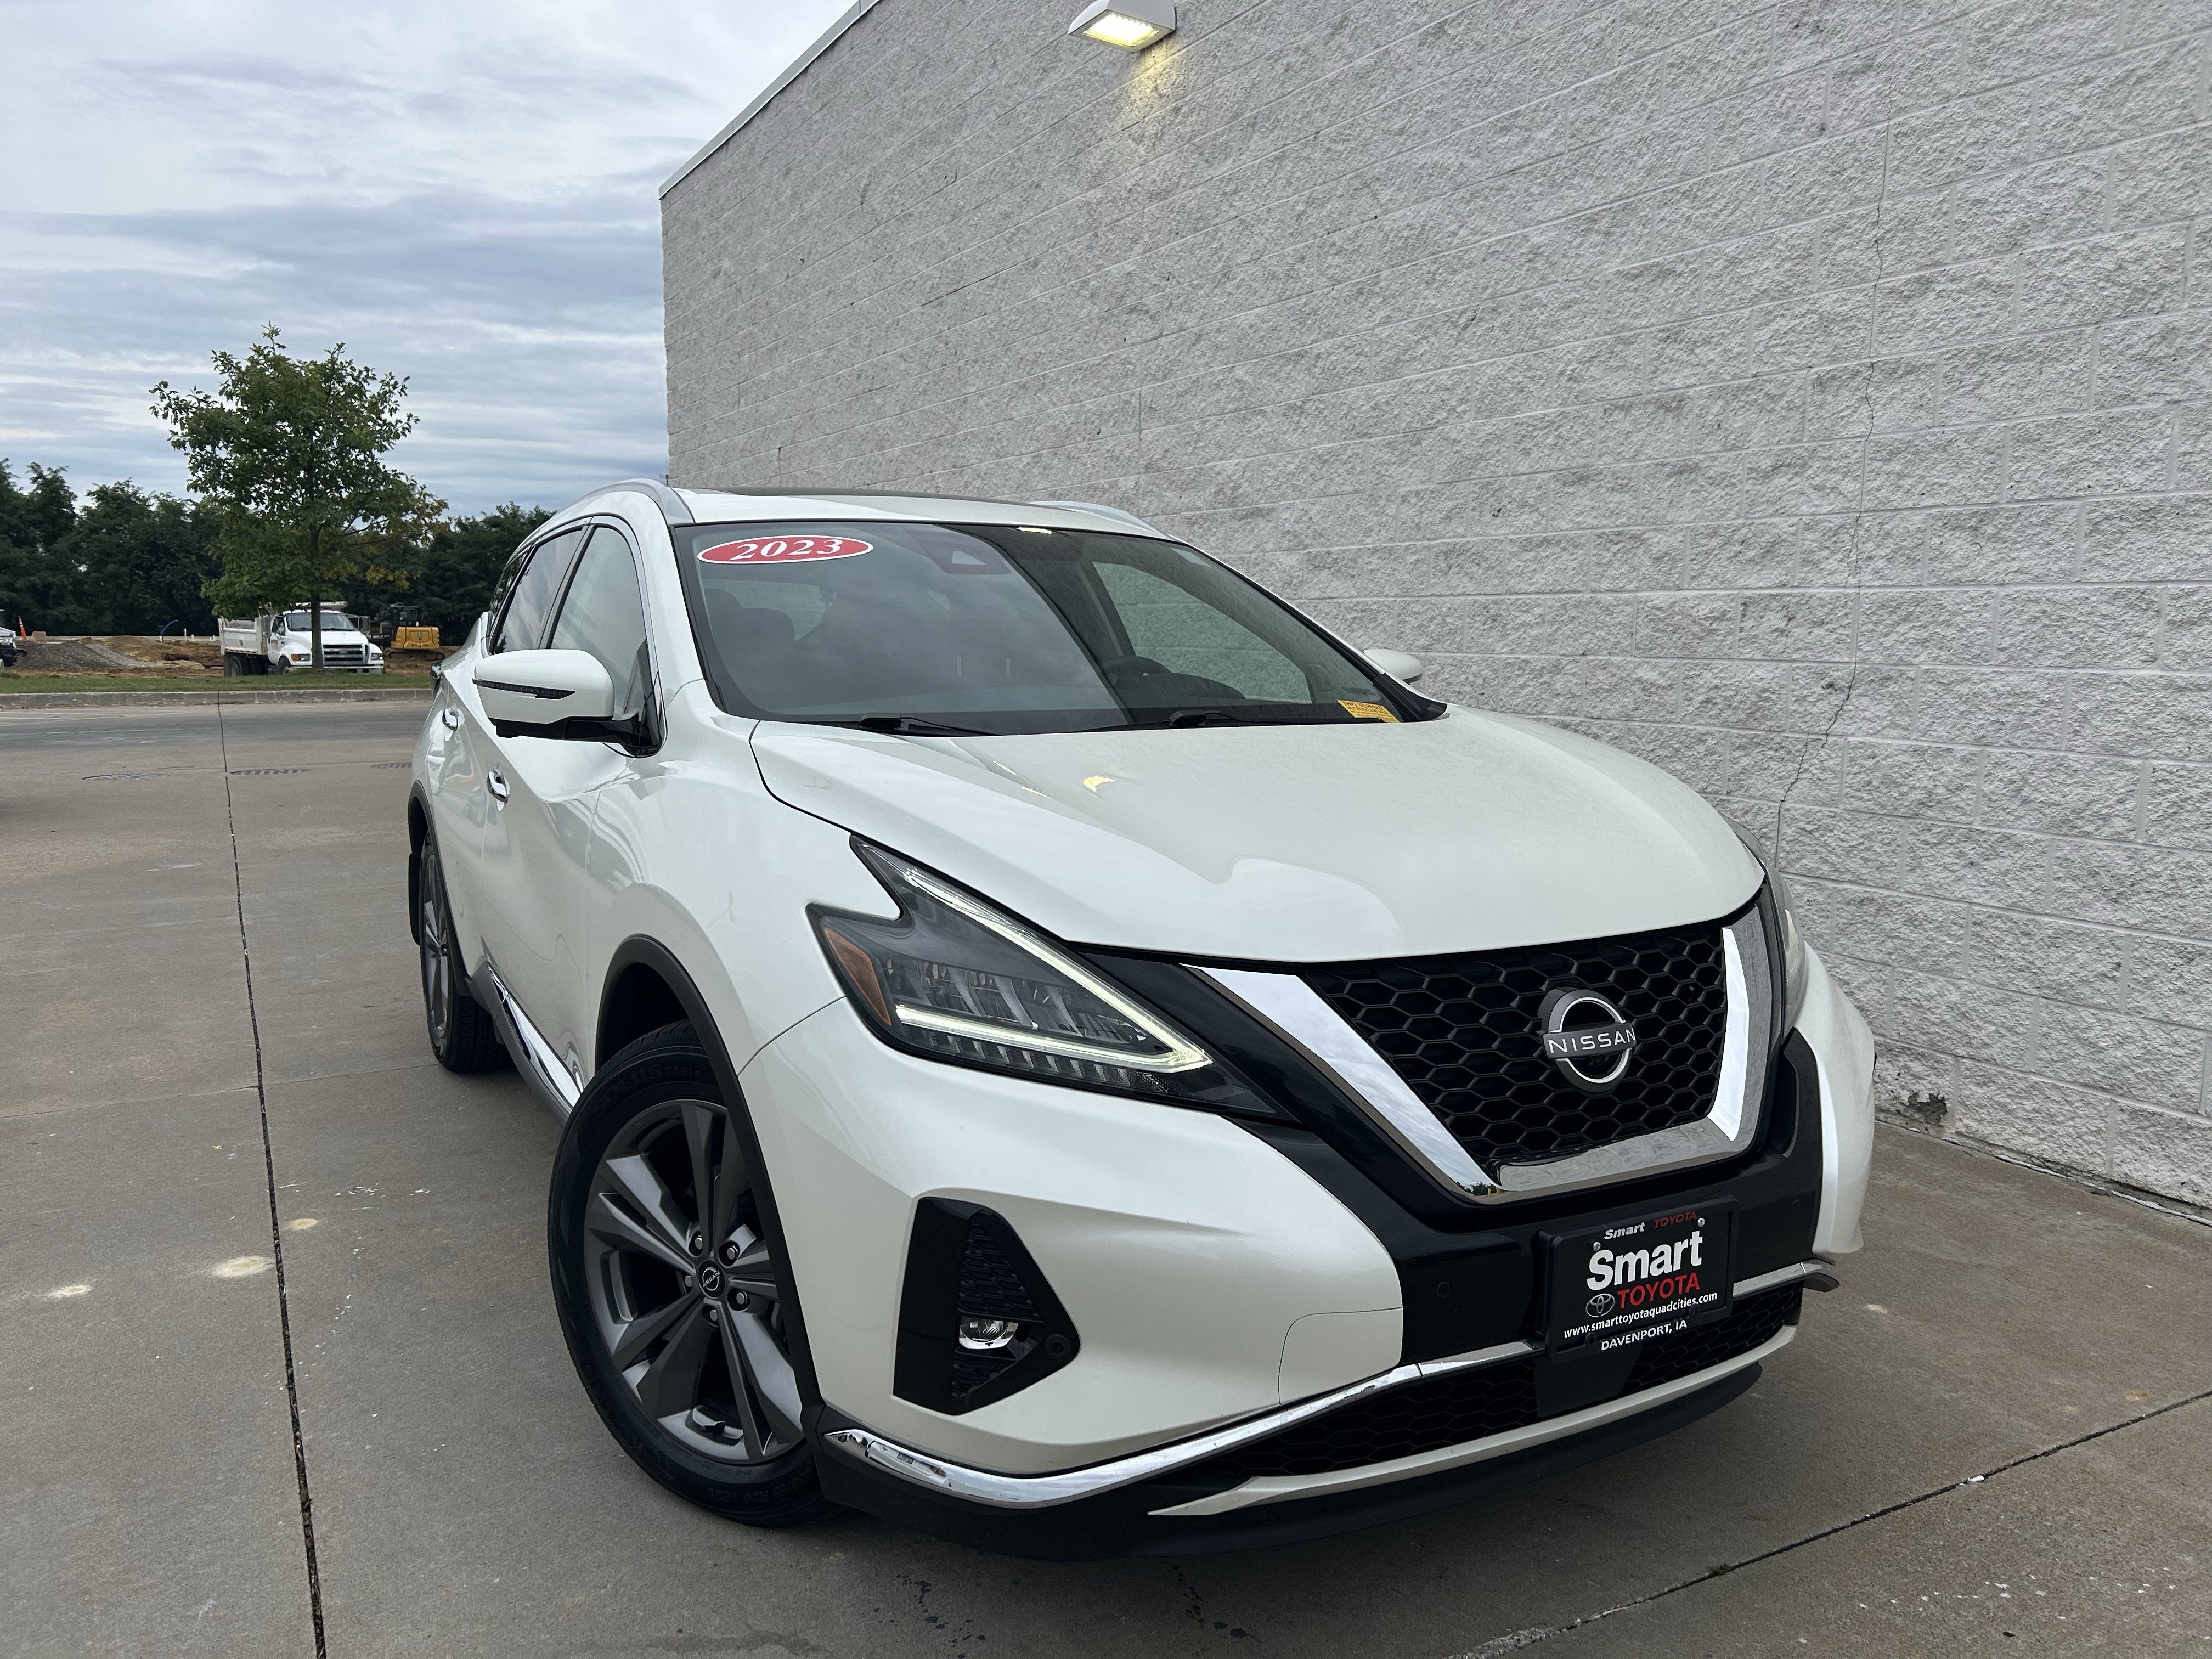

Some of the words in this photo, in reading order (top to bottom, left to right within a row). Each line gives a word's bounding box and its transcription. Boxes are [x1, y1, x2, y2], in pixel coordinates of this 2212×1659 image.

[729, 539, 844, 561] 2023
[1548, 1027, 1636, 1054] NISSAN
[1604, 1222, 1645, 1240] Smart
[1653, 1211, 1696, 1228] TOYOTA
[1587, 1230, 1703, 1290] Smart
[1617, 1272, 1700, 1309] TOYOTA
[1564, 1292, 1718, 1339] www.smarttoyotaquadcities.com
[1601, 1323, 1673, 1351] DAVENPORT,
[1675, 1319, 1688, 1330] IA
